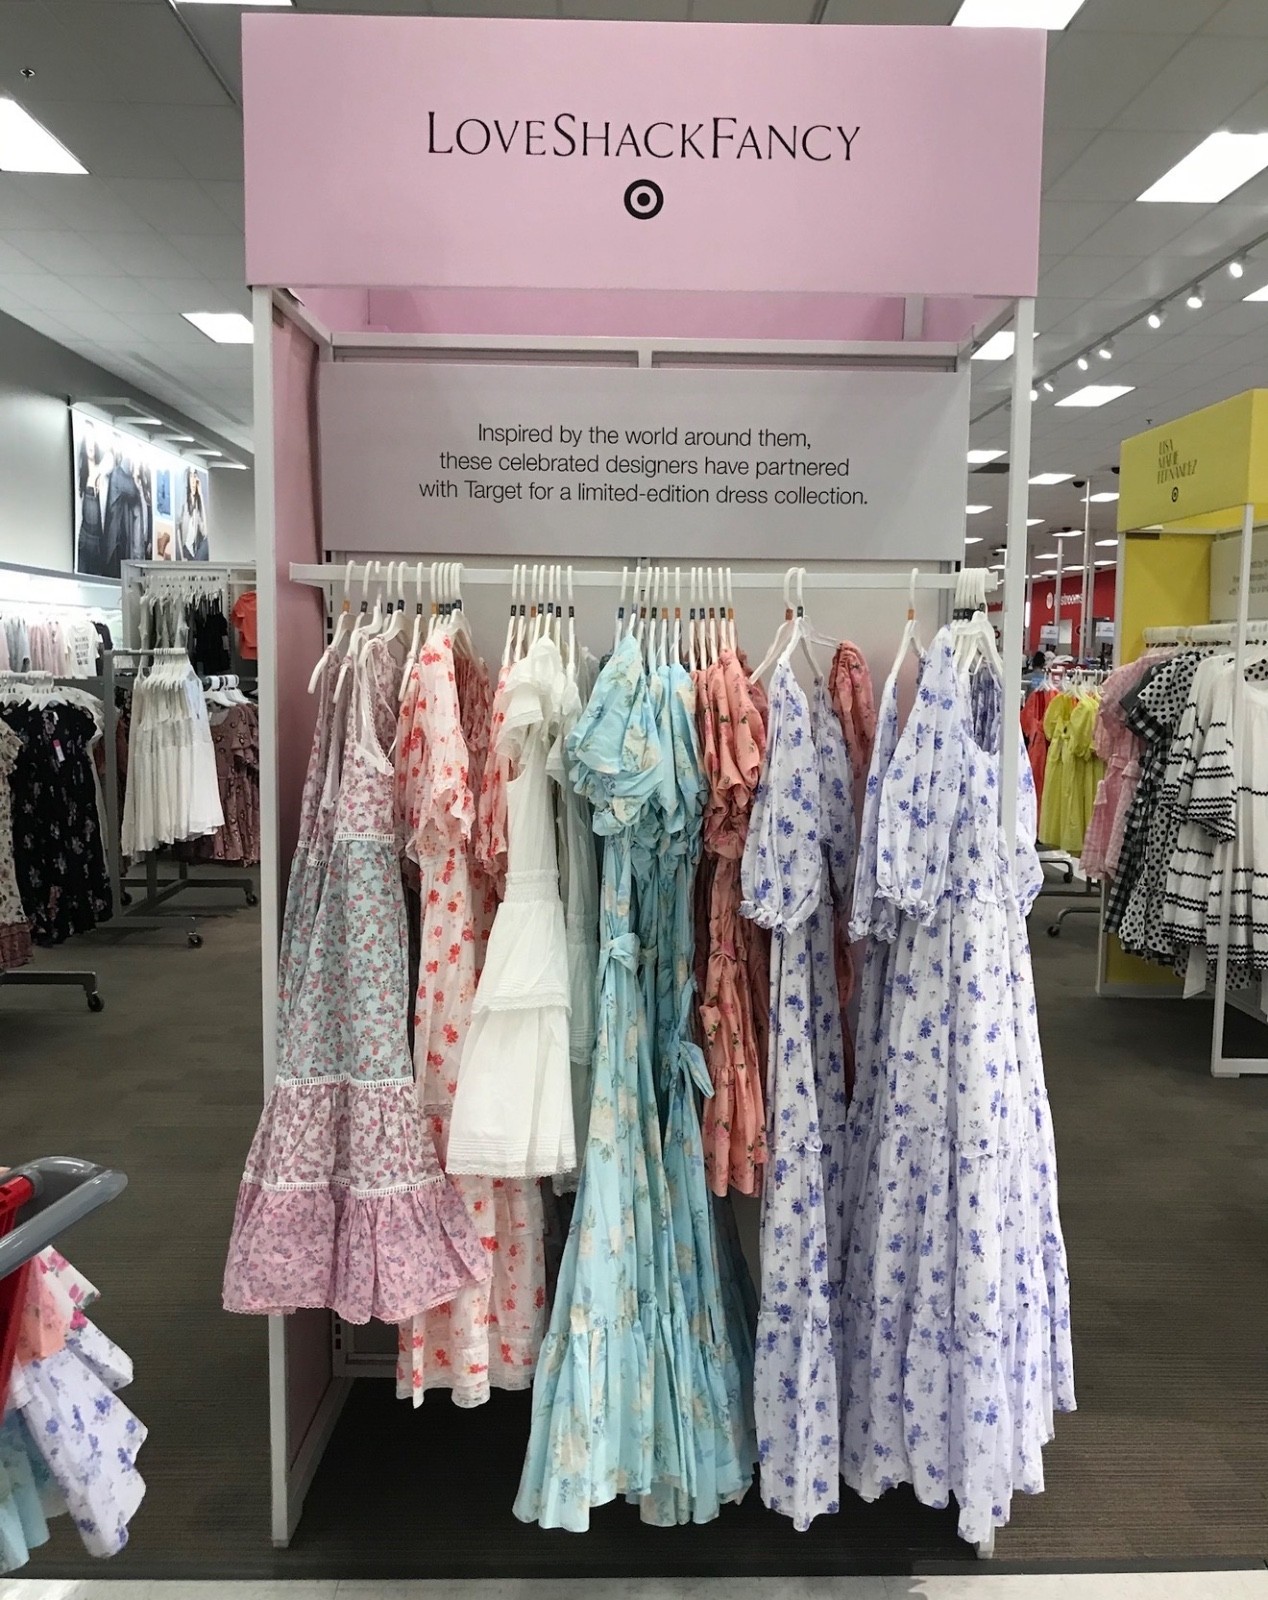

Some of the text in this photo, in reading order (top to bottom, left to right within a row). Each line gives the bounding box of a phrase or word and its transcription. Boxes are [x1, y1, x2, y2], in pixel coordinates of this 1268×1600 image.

[478, 423, 811, 450] Inspired by the world around them,
[439, 451, 850, 480] these celebrated designers have partnered
[418, 479, 868, 505] with Target for a limited-edition dress collection.
